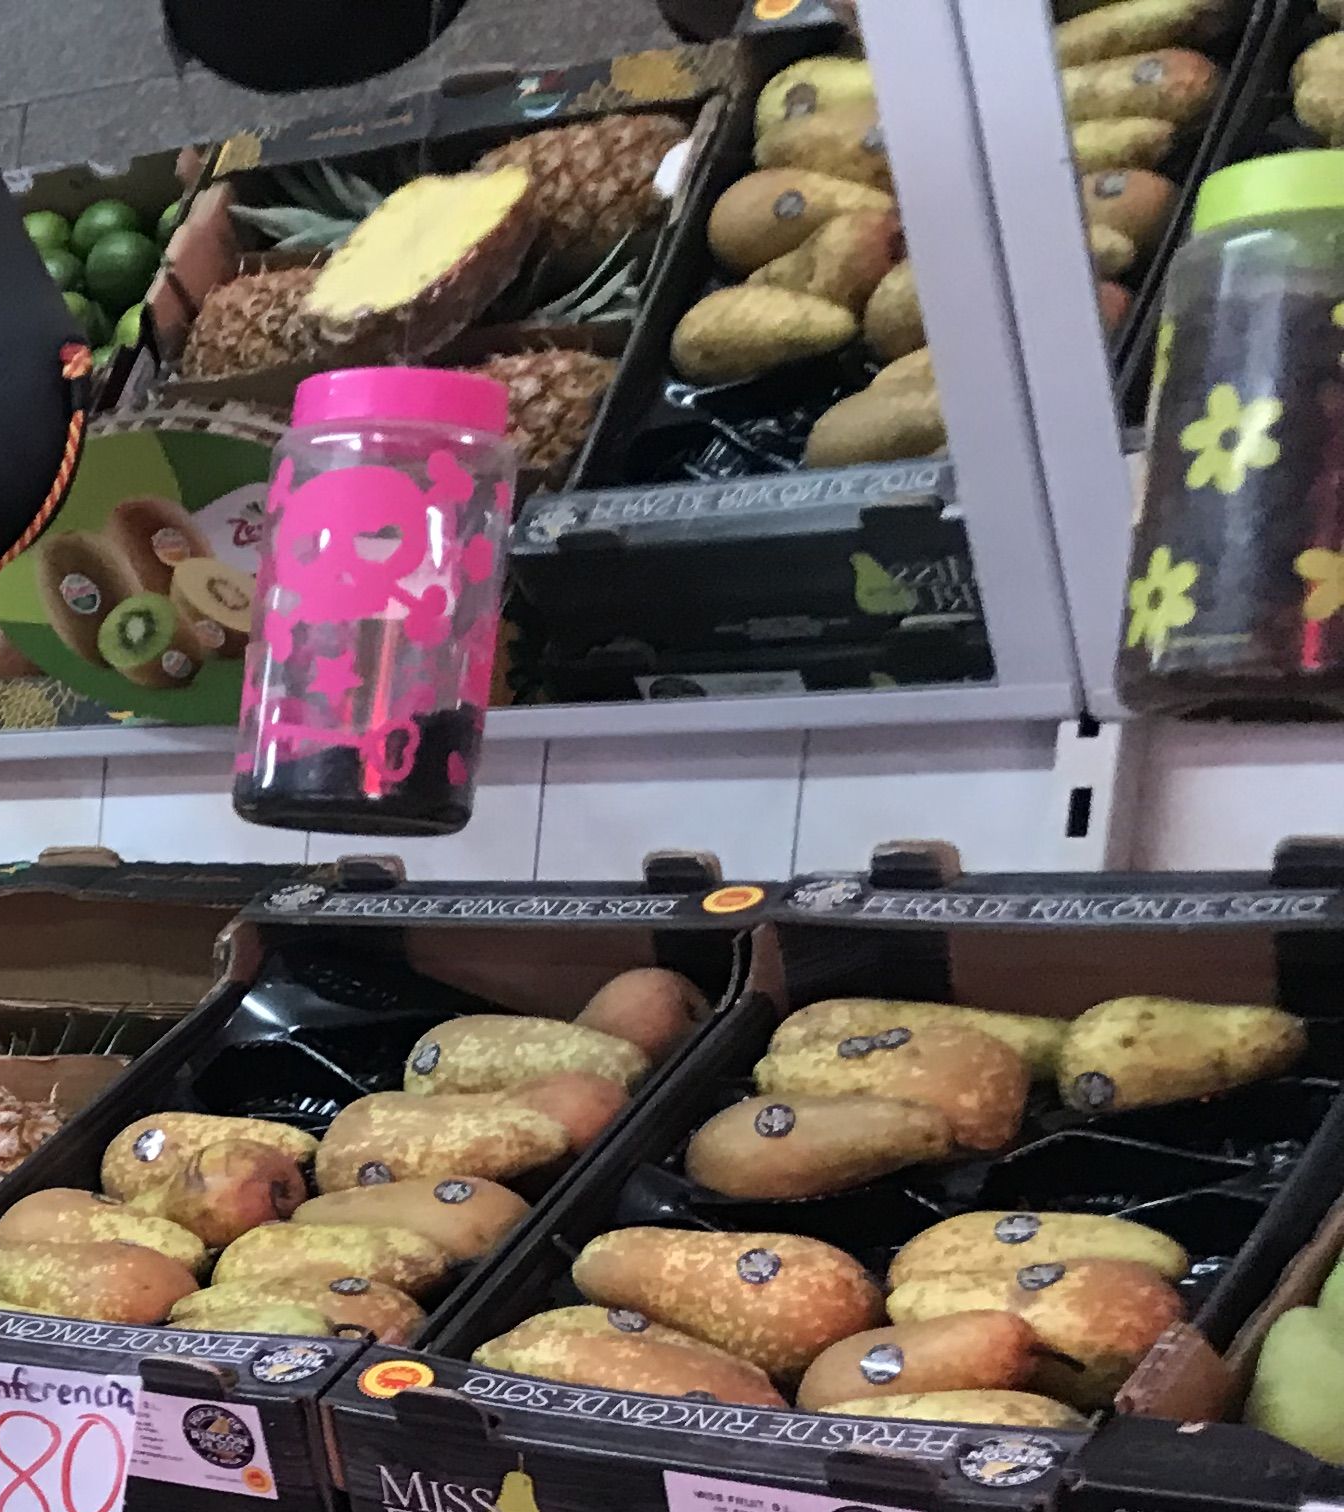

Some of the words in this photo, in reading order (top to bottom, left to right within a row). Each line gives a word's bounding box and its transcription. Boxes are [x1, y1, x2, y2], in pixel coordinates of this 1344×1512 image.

[319, 898, 409, 916] PERAS
[408, 898, 441, 916] DE
[557, 898, 593, 918] DE
[598, 898, 679, 917] SOTO
[862, 897, 969, 919] PERAS
[973, 898, 1013, 919] DE
[1171, 898, 1213, 920] DE
[1223, 898, 1331, 919] SOTO
[113, 1329, 157, 1351] DE
[157, 1333, 260, 1360] PERAS
[463, 1375, 559, 1407] SOTO
[563, 1393, 611, 1417] DE
[768, 1420, 823, 1443] DE
[821, 1422, 960, 1456] PERAS
